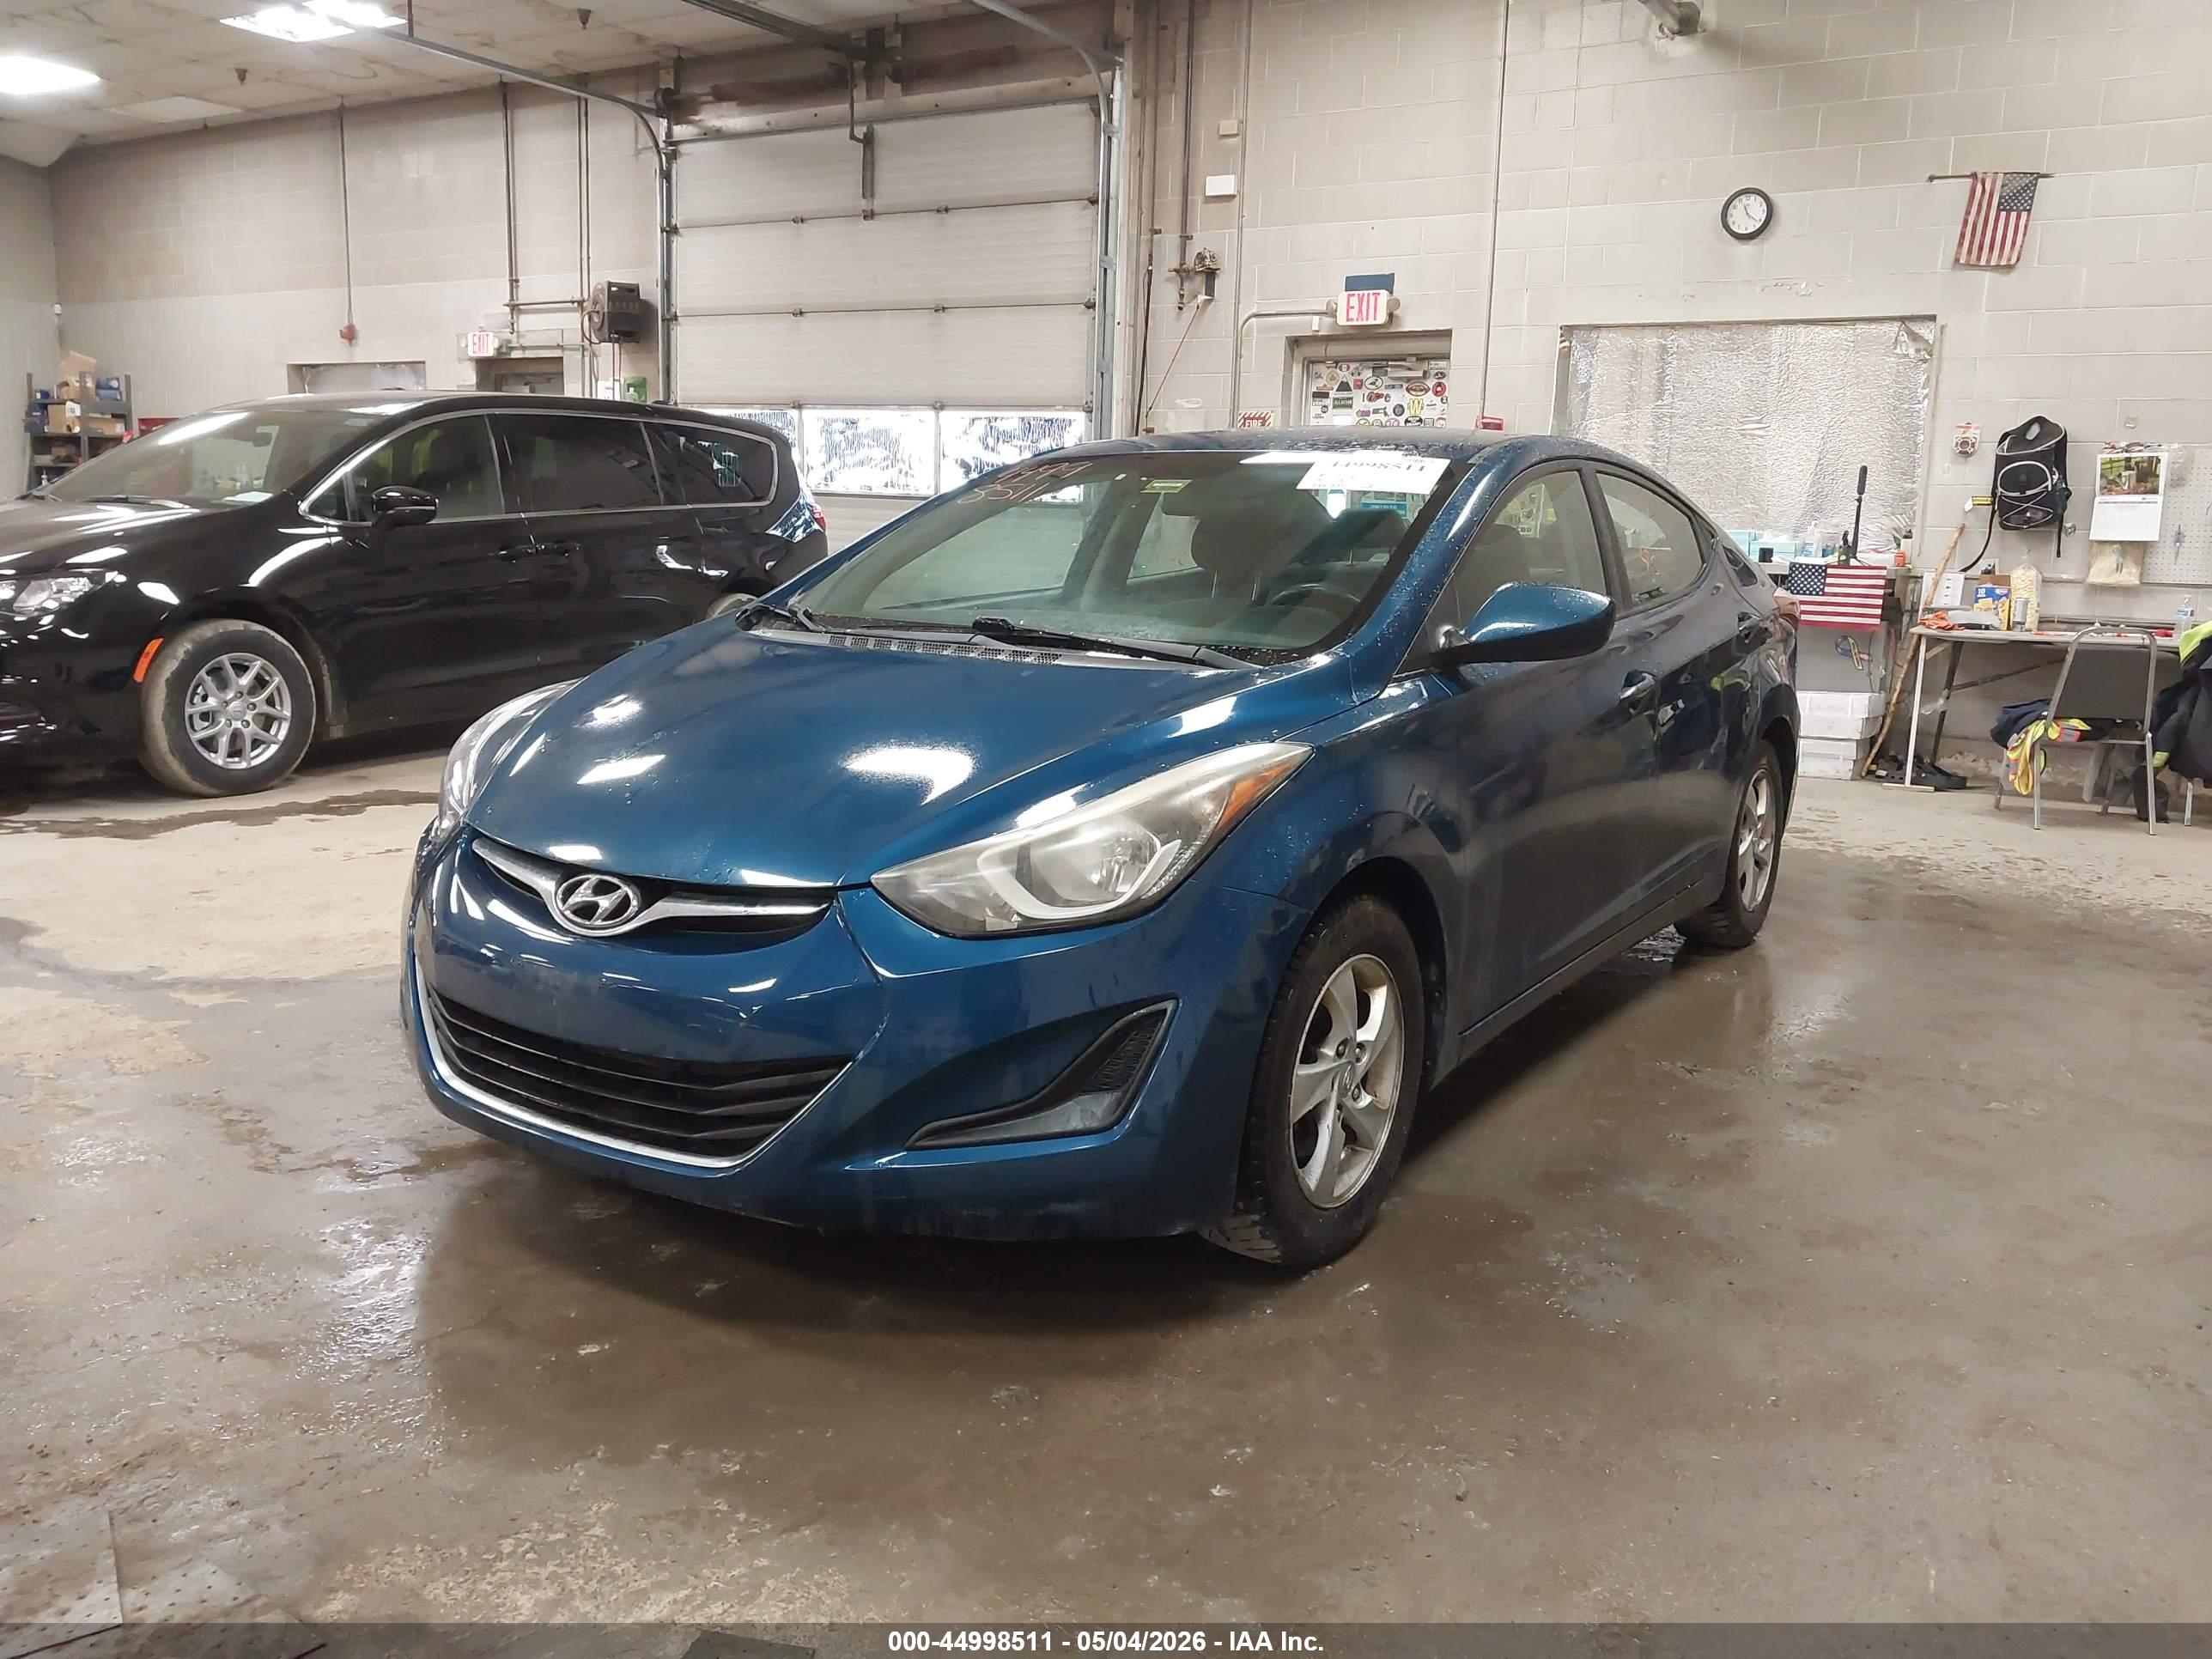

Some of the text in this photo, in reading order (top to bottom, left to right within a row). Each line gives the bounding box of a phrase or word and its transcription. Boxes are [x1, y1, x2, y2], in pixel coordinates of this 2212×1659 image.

[1346, 292, 1381, 322] EXIT
[472, 333, 489, 353] EXIT
[1245, 419, 1265, 428] FIRE
